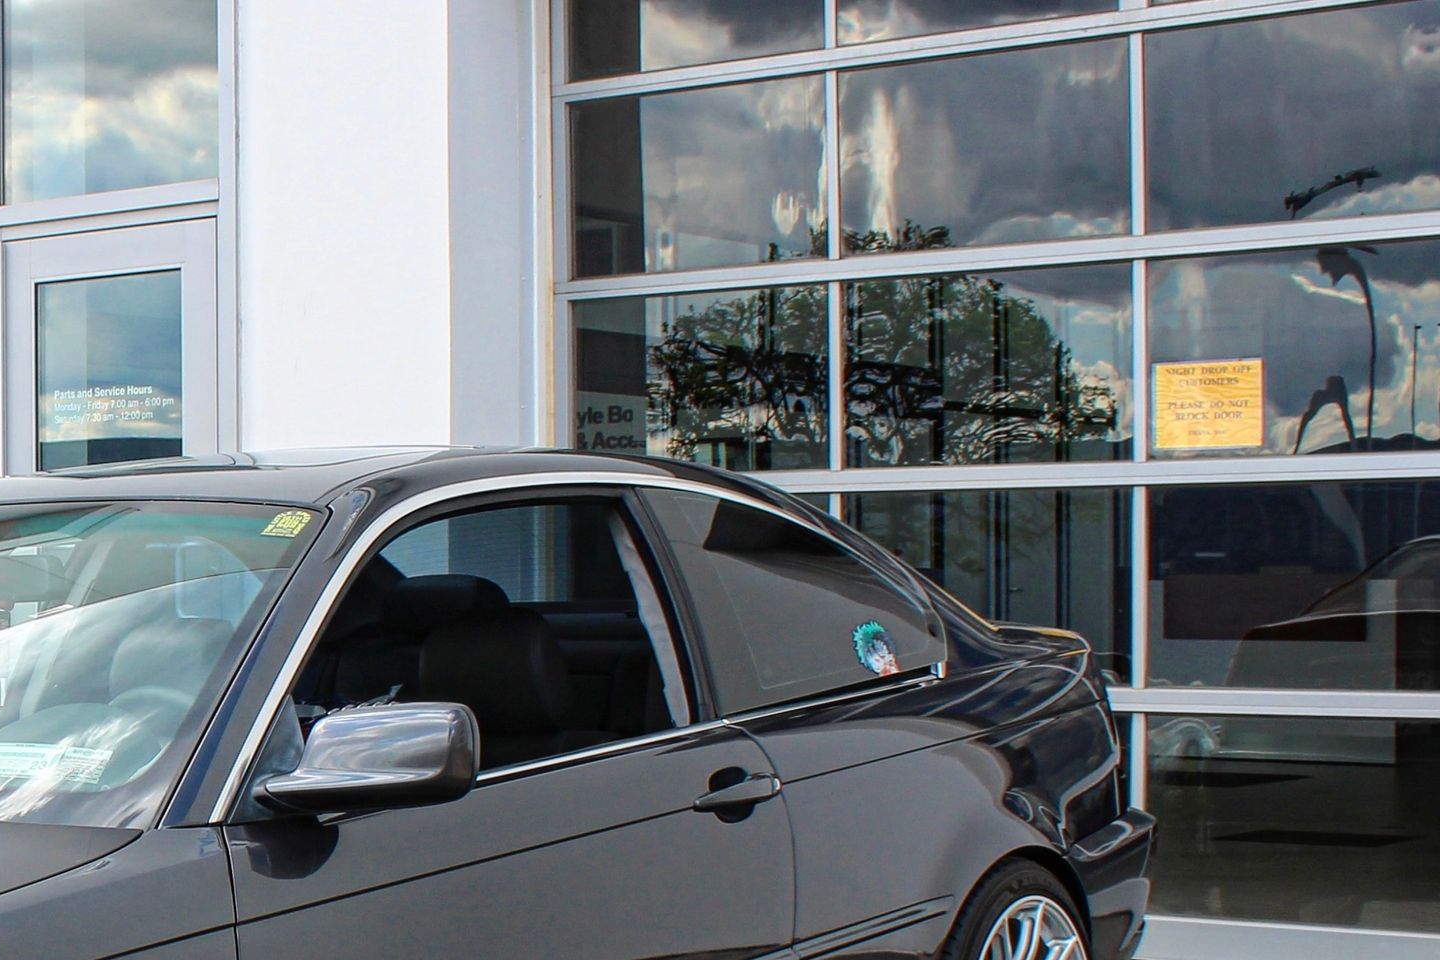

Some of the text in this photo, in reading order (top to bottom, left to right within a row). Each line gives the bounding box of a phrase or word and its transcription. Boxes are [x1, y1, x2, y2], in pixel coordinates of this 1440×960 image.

[1201, 366, 1228, 375] DROP
[53, 385, 153, 400] Parts and Service Hours
[53, 402, 81, 412] Monday
[87, 400, 110, 411] Friday
[127, 399, 139, 408] am
[162, 398, 175, 408] pm
[1209, 400, 1224, 409] DO
[103, 413, 114, 422] am
[121, 410, 140, 420] 12:00
[141, 411, 153, 420] pm
